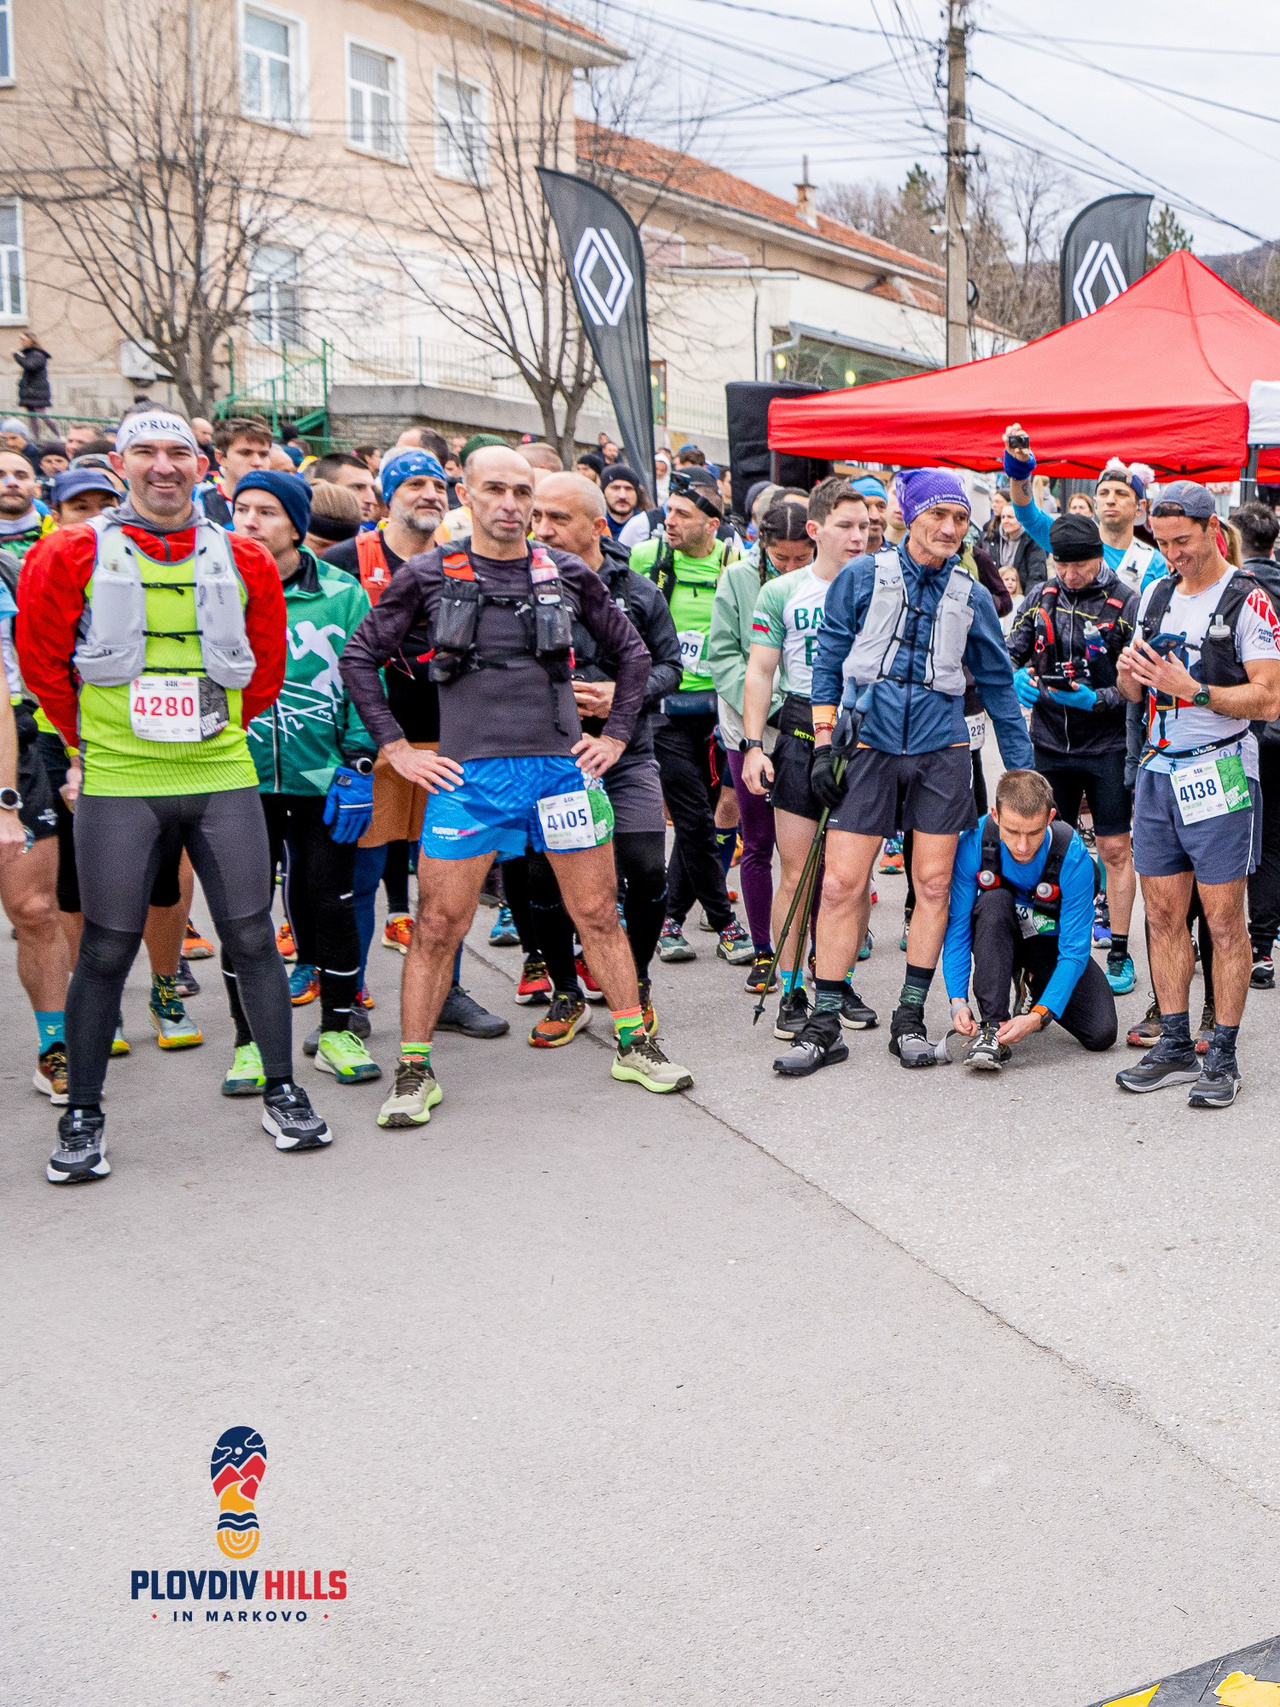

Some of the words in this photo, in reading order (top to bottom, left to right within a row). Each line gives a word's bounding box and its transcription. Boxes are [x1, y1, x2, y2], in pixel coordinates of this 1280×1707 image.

[134, 696, 194, 717] 4280
[1179, 778, 1217, 803] 4138
[547, 808, 588, 831] 4105
